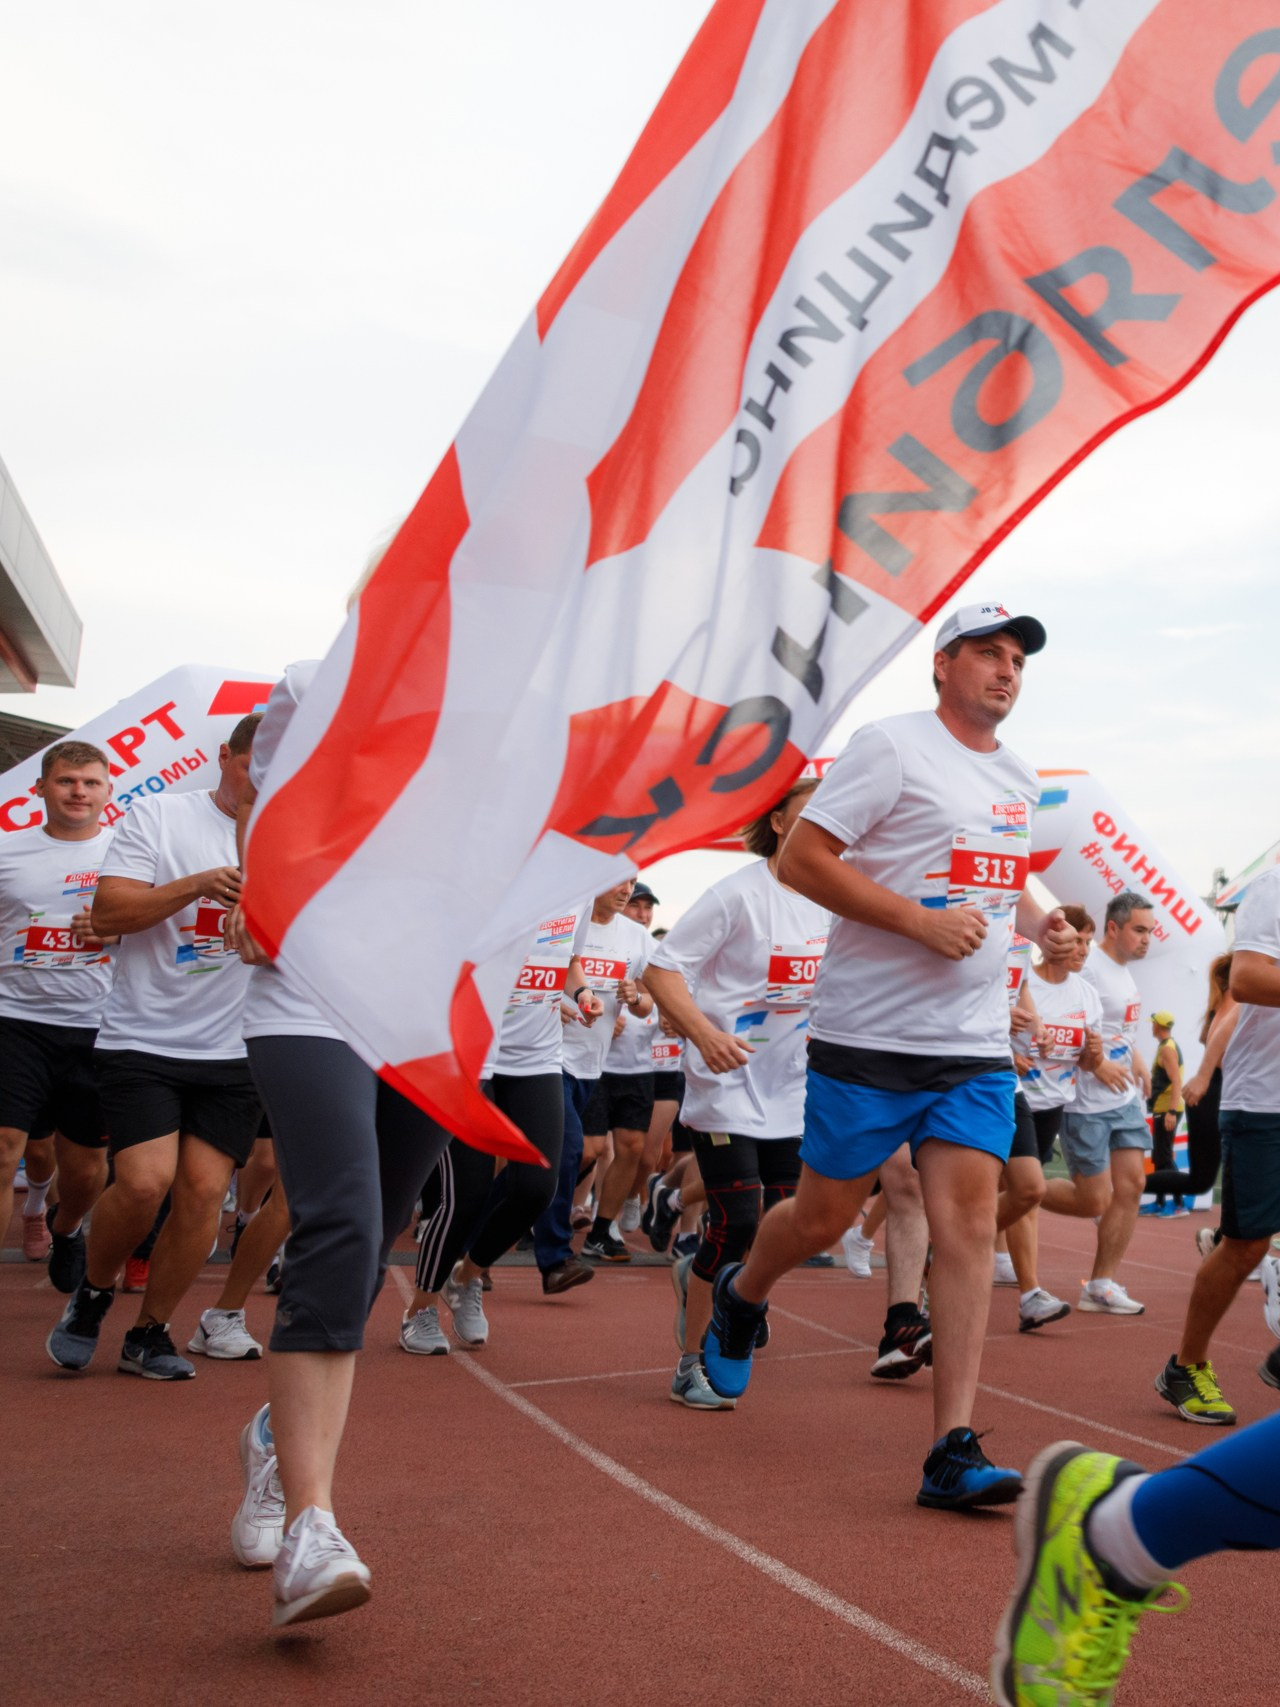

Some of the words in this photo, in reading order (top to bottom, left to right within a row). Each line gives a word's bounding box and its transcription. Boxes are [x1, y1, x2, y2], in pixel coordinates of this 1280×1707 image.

[0, 701, 186, 832] СРТ
[973, 856, 1016, 886] 313
[1092, 810, 1203, 936] ФИНИШ
[519, 969, 556, 988] 270
[584, 960, 615, 976] 257
